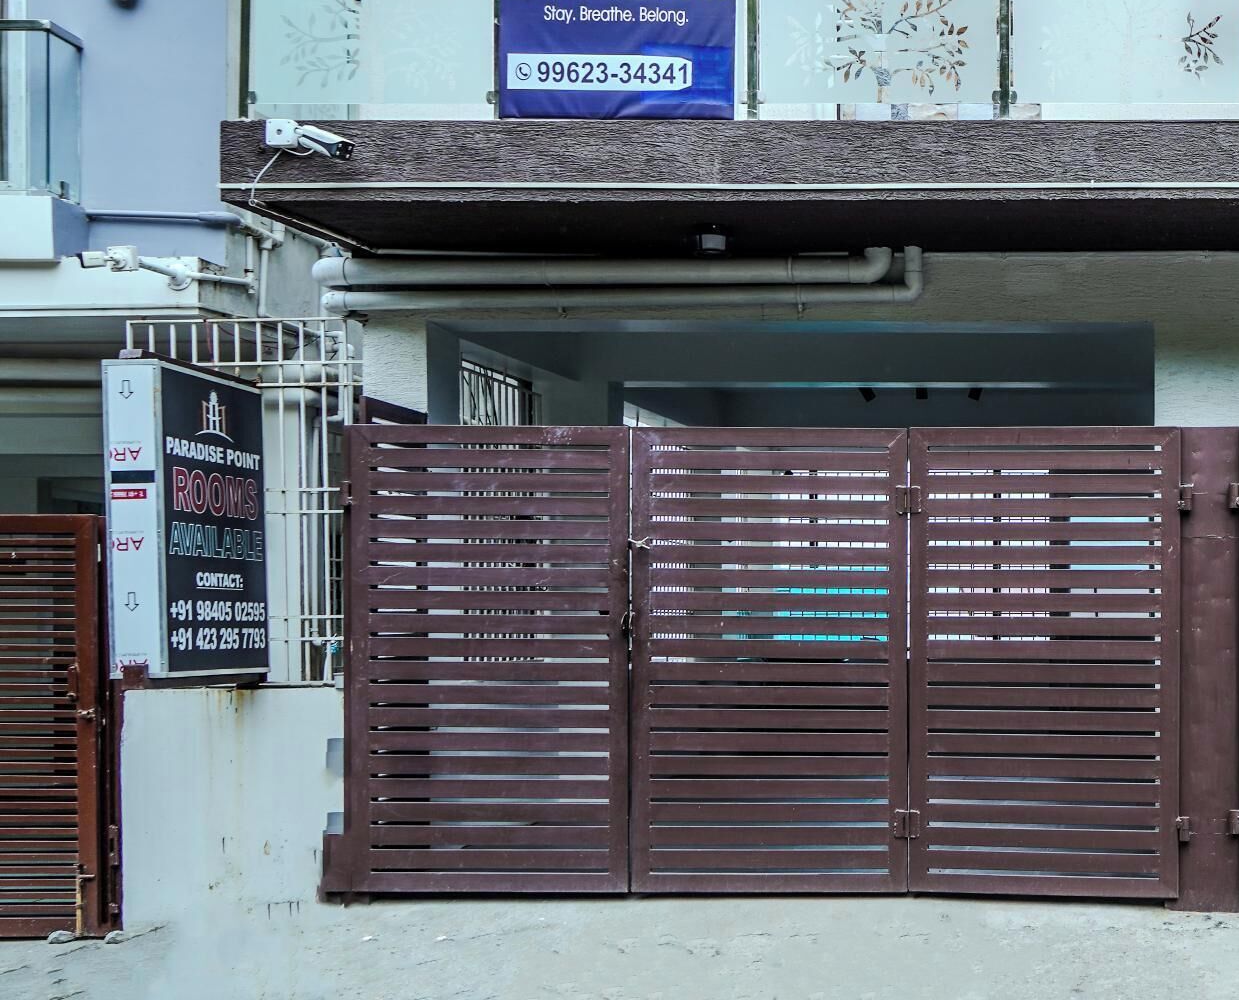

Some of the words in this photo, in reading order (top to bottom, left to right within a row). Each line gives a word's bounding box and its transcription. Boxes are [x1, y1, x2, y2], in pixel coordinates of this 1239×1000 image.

[543, 6, 576, 24] Stay.
[580, 7, 635, 22] Breathe.
[639, 8, 689, 26] Belong.
[537, 61, 688, 84] 99623-34341
[166, 436, 225, 464] PARADISE
[226, 448, 260, 470] POINT
[172, 466, 258, 521] ROOMS
[169, 521, 263, 562] AVAILABLE
[196, 571, 243, 588] CONTACT:
[170, 600, 193, 620] +91
[196, 601, 232, 621] 98405
[234, 602, 265, 621] 02595
[170, 628, 193, 650] +91
[196, 627, 217, 650] 423
[220, 627, 239, 650] 295
[241, 628, 266, 649] 7793
